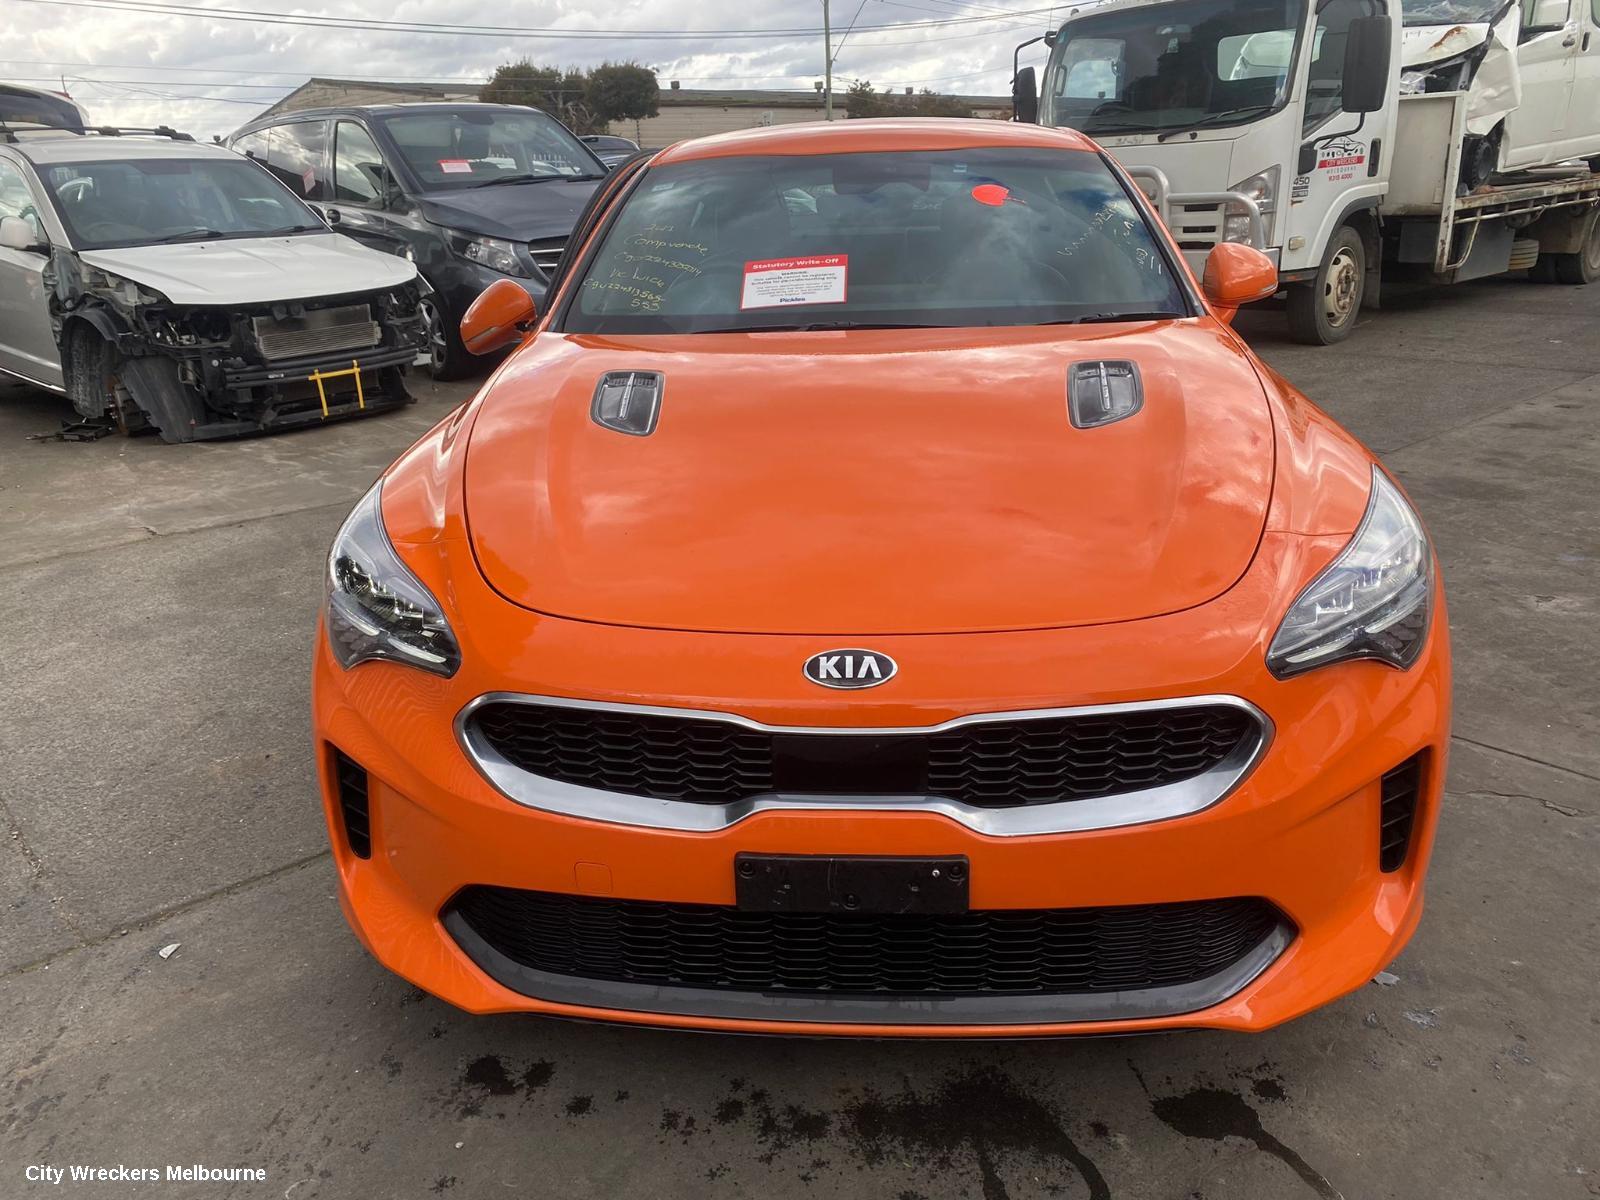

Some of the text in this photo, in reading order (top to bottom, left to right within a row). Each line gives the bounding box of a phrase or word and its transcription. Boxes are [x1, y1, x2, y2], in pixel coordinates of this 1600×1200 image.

[1293, 176, 1310, 185] 450
[752, 261, 795, 270] Statutory
[818, 655, 882, 679] KIA
